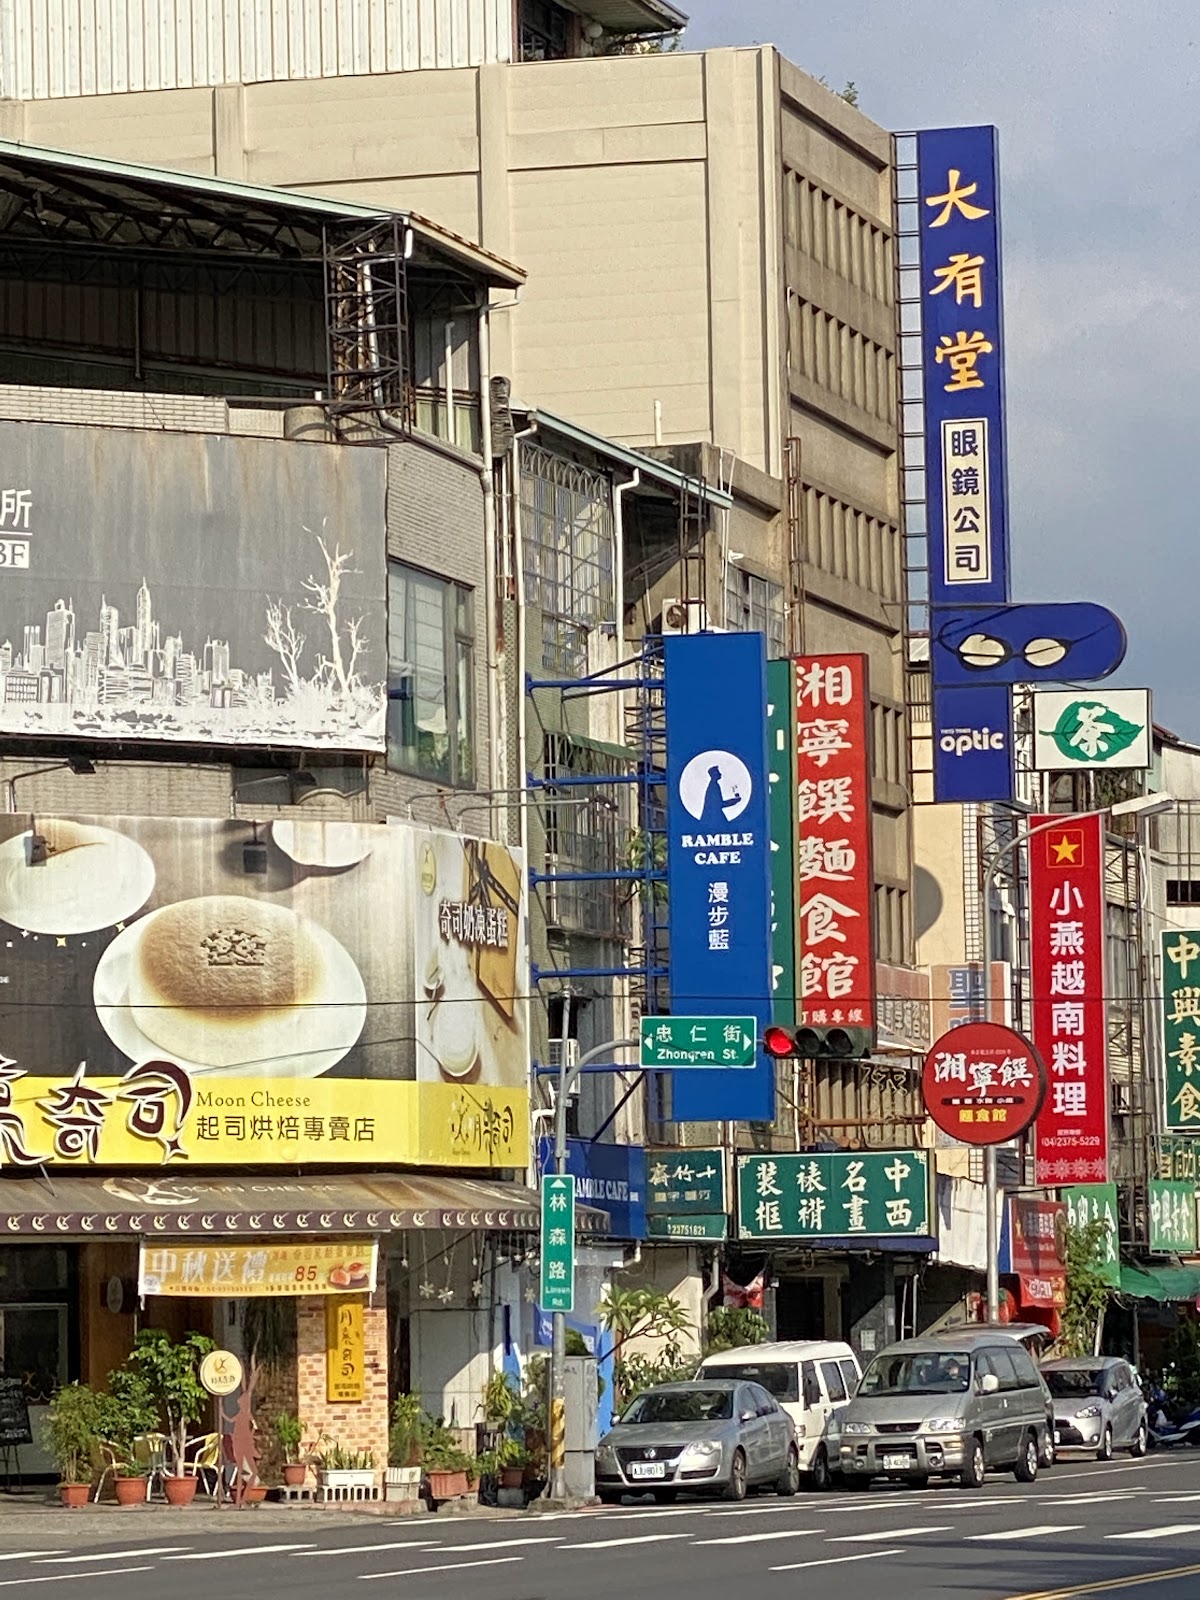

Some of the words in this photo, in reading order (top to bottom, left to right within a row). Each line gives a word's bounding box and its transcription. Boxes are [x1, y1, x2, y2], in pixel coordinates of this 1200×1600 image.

[925, 168, 993, 393] 大有堂
[0, 488, 33, 528] 所
[950, 428, 981, 573] 眼鏡公司
[940, 726, 1004, 757] optic
[681, 832, 754, 848] RAMBLE
[694, 851, 741, 866] CAFE
[708, 881, 730, 950] 漫步藍
[1049, 880, 1088, 1117] 小燕越南料理
[656, 1024, 742, 1043] 忠仁街
[1166, 934, 1200, 1123] 中興素食
[656, 1048, 715, 1062] Zhongren
[722, 1048, 740, 1060] St.
[934, 1052, 1034, 1097] 湘寧饌
[196, 1091, 246, 1107] Moon
[250, 1091, 311, 1107] Cheese
[196, 1115, 376, 1142] 起司烘焙專賣店
[574, 1177, 606, 1200] AMBLE
[605, 1180, 629, 1202] CAFE
[548, 1192, 568, 1280] 林森路
[294, 1265, 318, 1282] 85
